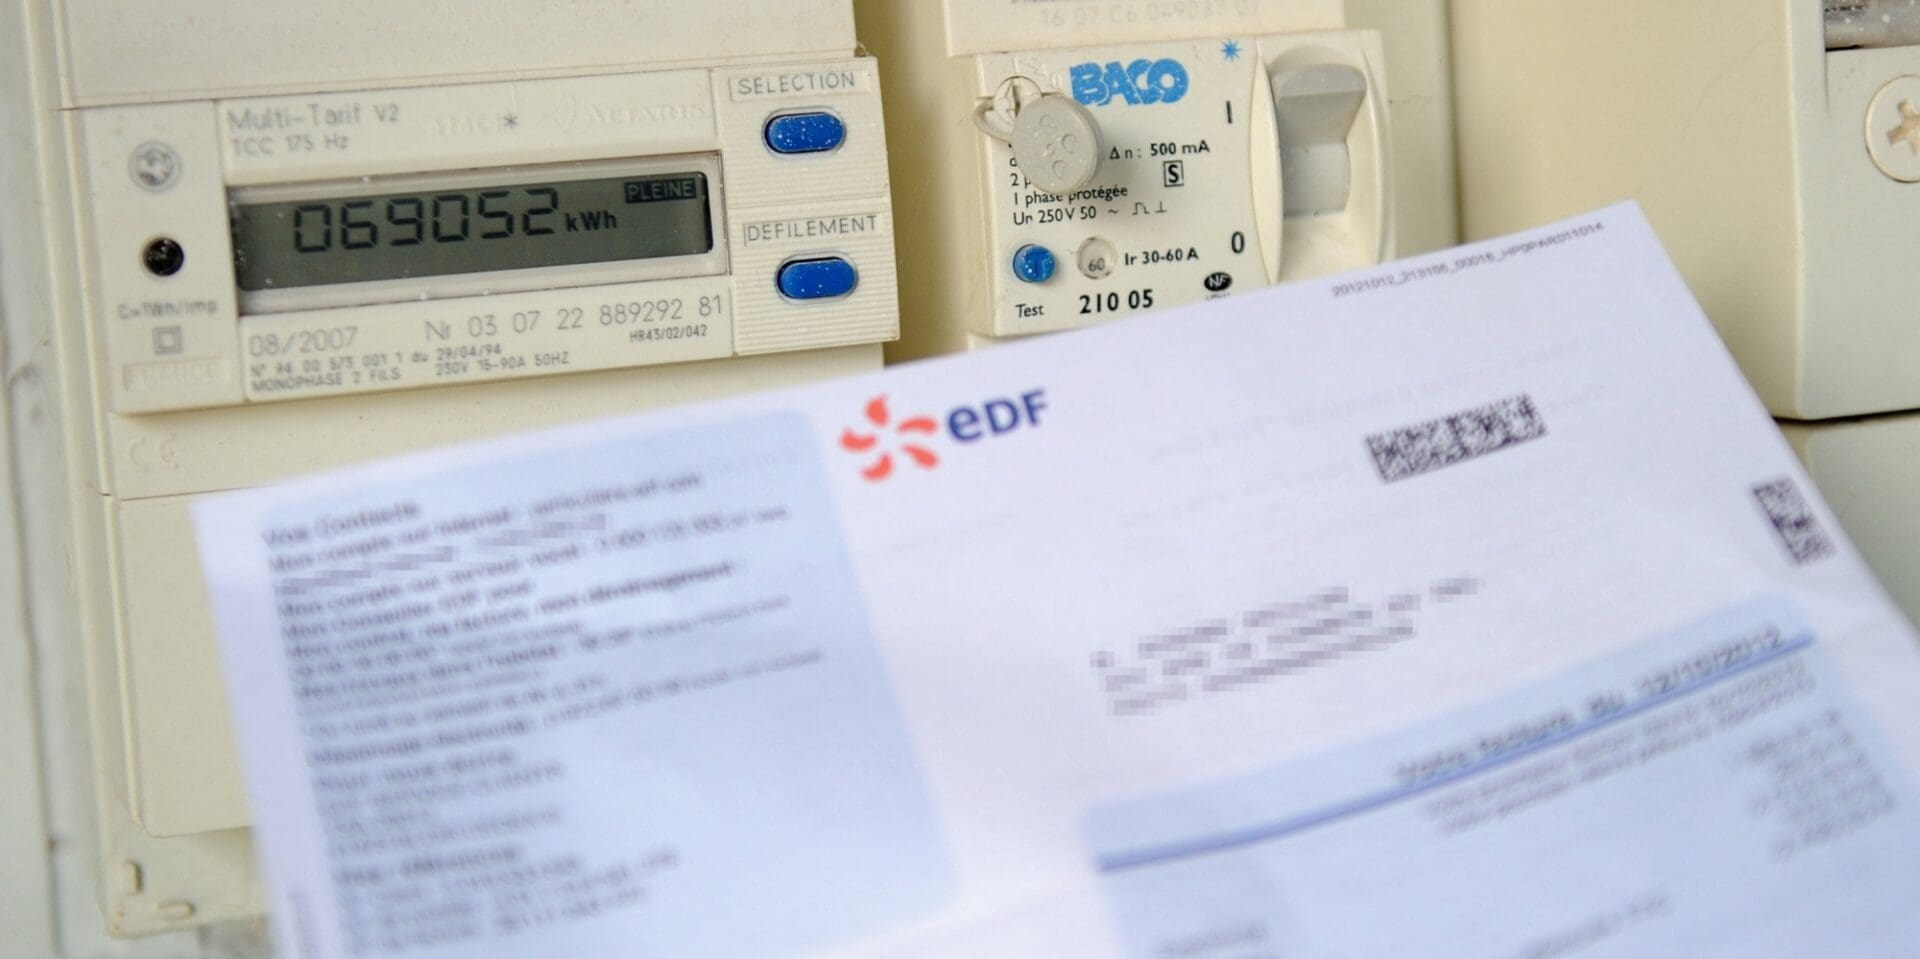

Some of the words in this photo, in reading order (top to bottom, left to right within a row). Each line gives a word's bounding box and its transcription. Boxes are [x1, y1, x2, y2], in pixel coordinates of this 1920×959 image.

[737, 72, 857, 97] SELECTION
[1069, 57, 1190, 107] BACO
[226, 105, 362, 132] Multi-Tarif
[372, 104, 400, 123] V2
[230, 137, 274, 156] TCC
[286, 135, 315, 152] 175
[324, 133, 350, 150] Hz
[1150, 143, 1177, 157] 500
[1182, 139, 1211, 154] mA
[627, 178, 696, 201] PLEINE
[1067, 184, 1129, 205] protégée
[294, 188, 560, 254] 069052
[565, 208, 619, 234] kWh
[746, 214, 879, 242] DEFILEMENT
[1088, 258, 1106, 273] 60
[1142, 249, 1184, 265] 30-60
[1187, 247, 1199, 261] A
[1015, 305, 1045, 318] Test
[1079, 292, 1120, 316] 210
[1127, 289, 1154, 309] 05
[468, 315, 498, 338] 03
[511, 310, 541, 332] 07
[556, 306, 584, 330] 22
[599, 297, 684, 327] 889292
[698, 294, 724, 318] 81
[248, 325, 360, 358] 08/2007
[251, 371, 343, 394] MONOPHASE
[369, 366, 402, 383] FILS
[435, 360, 469, 377] 230V
[534, 351, 571, 367] 50HZ
